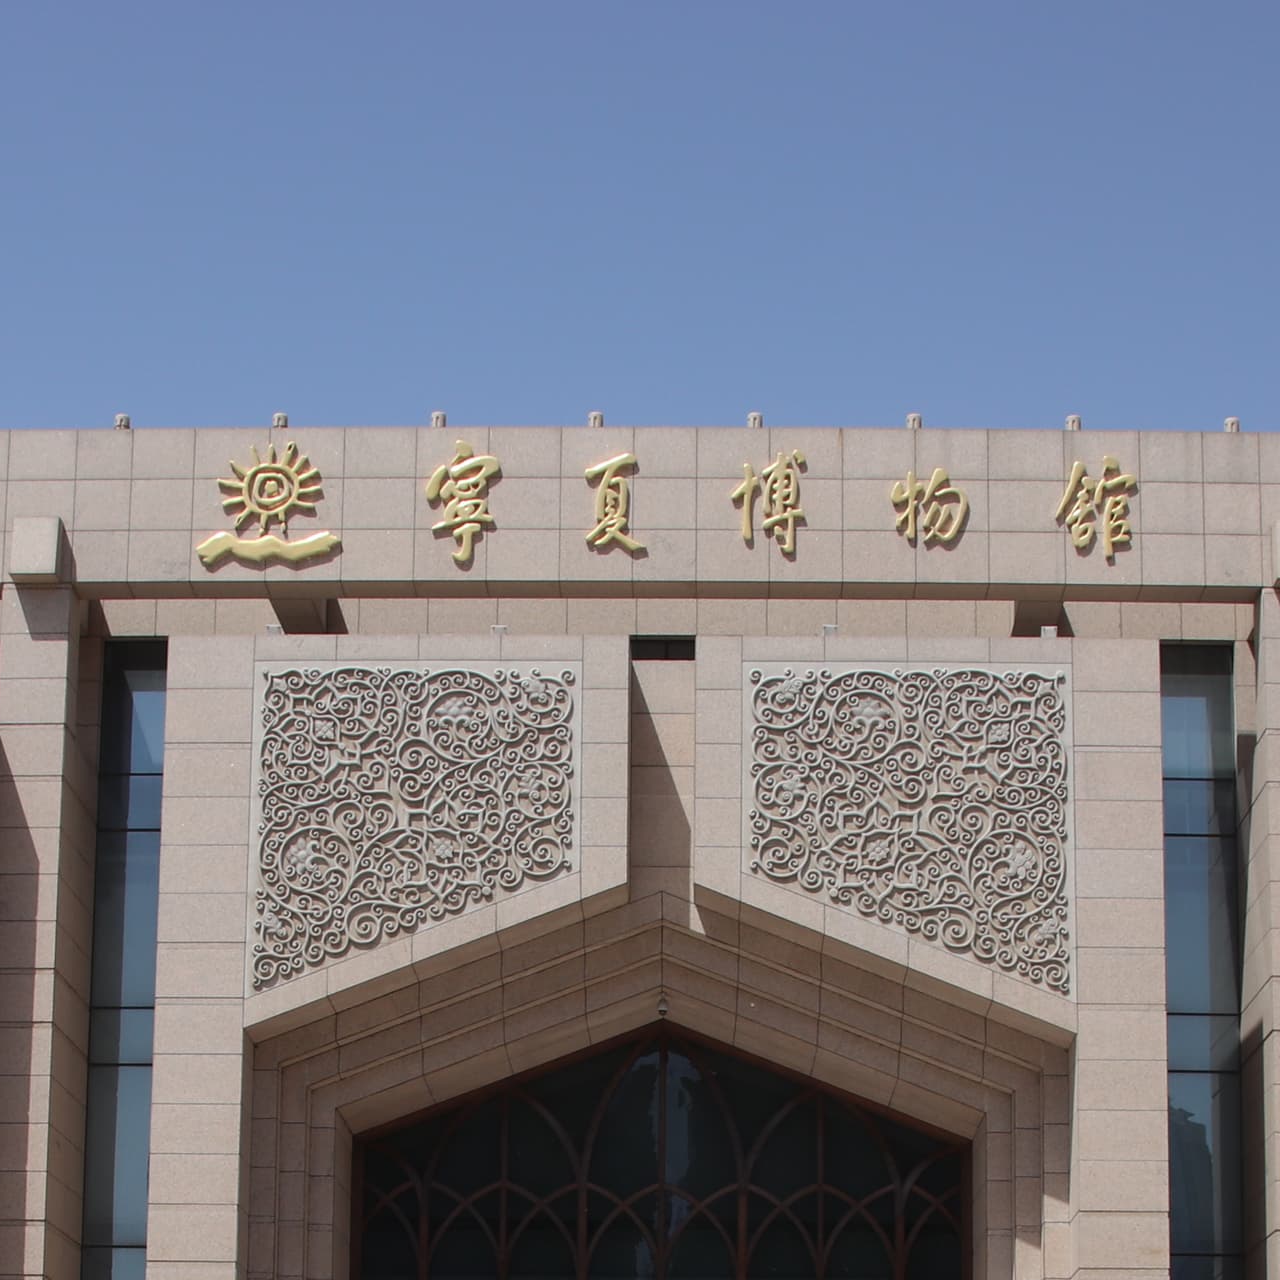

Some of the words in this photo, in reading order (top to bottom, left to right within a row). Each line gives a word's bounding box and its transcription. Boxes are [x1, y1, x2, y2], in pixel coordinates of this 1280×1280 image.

[425, 439, 1139, 564] 寧夏博物館
